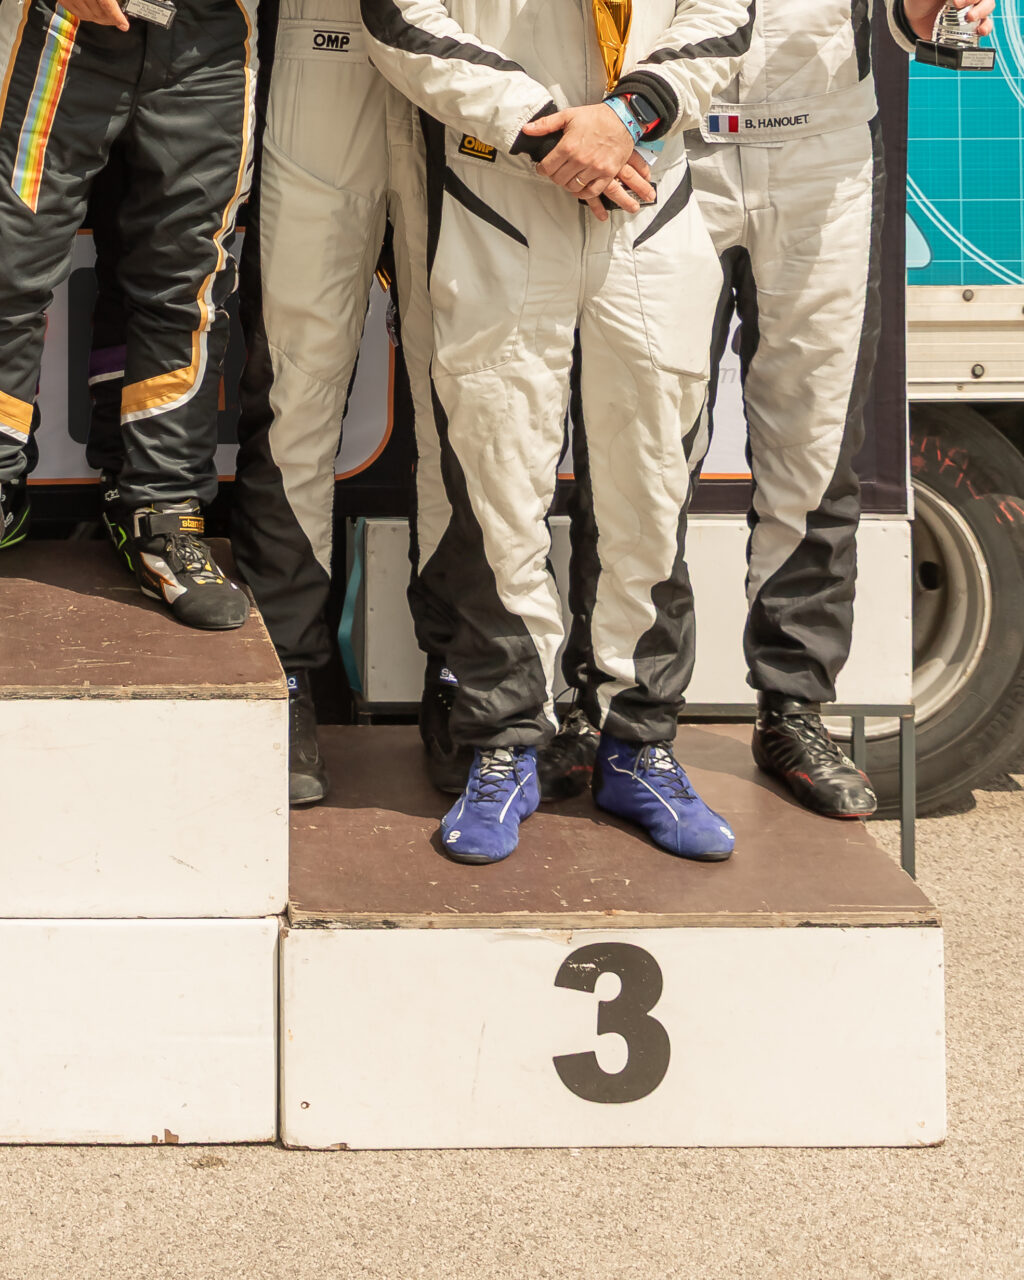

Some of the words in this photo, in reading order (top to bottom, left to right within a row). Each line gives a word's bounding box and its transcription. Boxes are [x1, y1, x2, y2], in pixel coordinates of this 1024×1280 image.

[313, 33, 350, 49] OMP
[744, 119, 756, 130] B.
[758, 113, 810, 129] HANOUET
[553, 942, 672, 1104] 3
